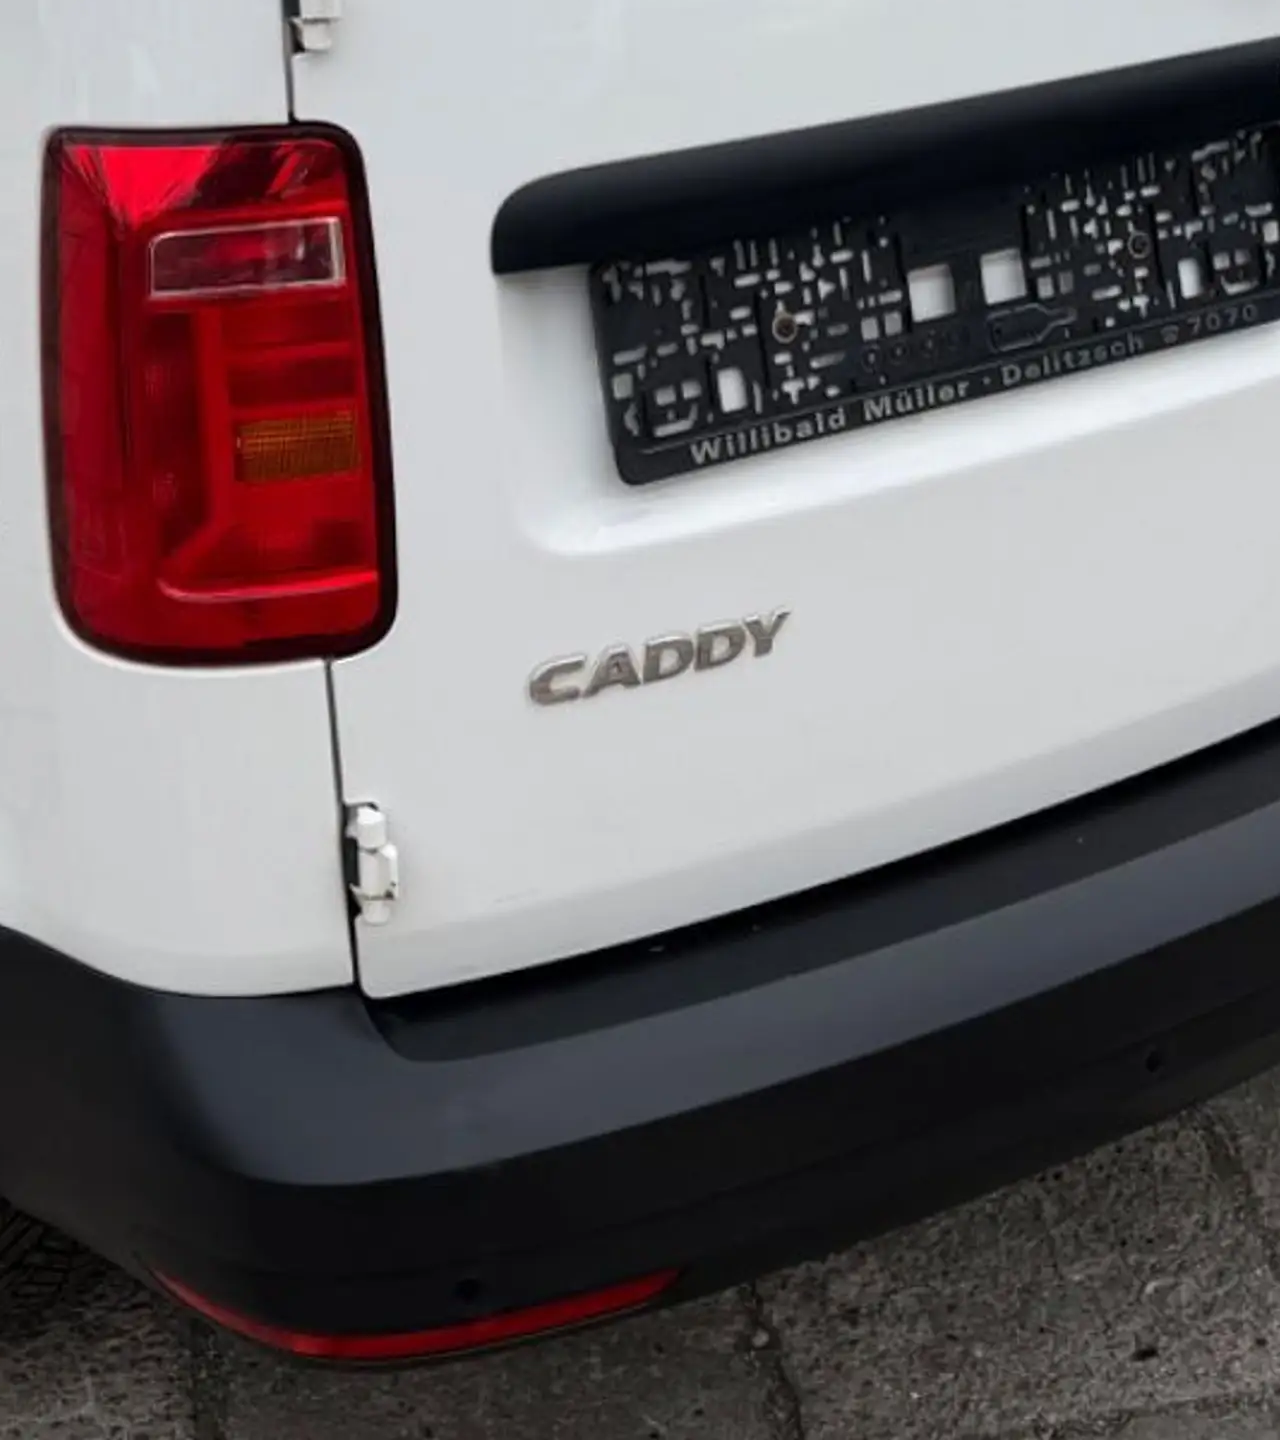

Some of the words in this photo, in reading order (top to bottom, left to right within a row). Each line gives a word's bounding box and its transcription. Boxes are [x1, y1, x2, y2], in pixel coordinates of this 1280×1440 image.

[690, 406, 847, 465] Willibald
[863, 379, 969, 422] Müller
[1001, 330, 1145, 387] Delitzsch
[1187, 303, 1259, 336] 7070
[527, 604, 793, 706] CADDY
